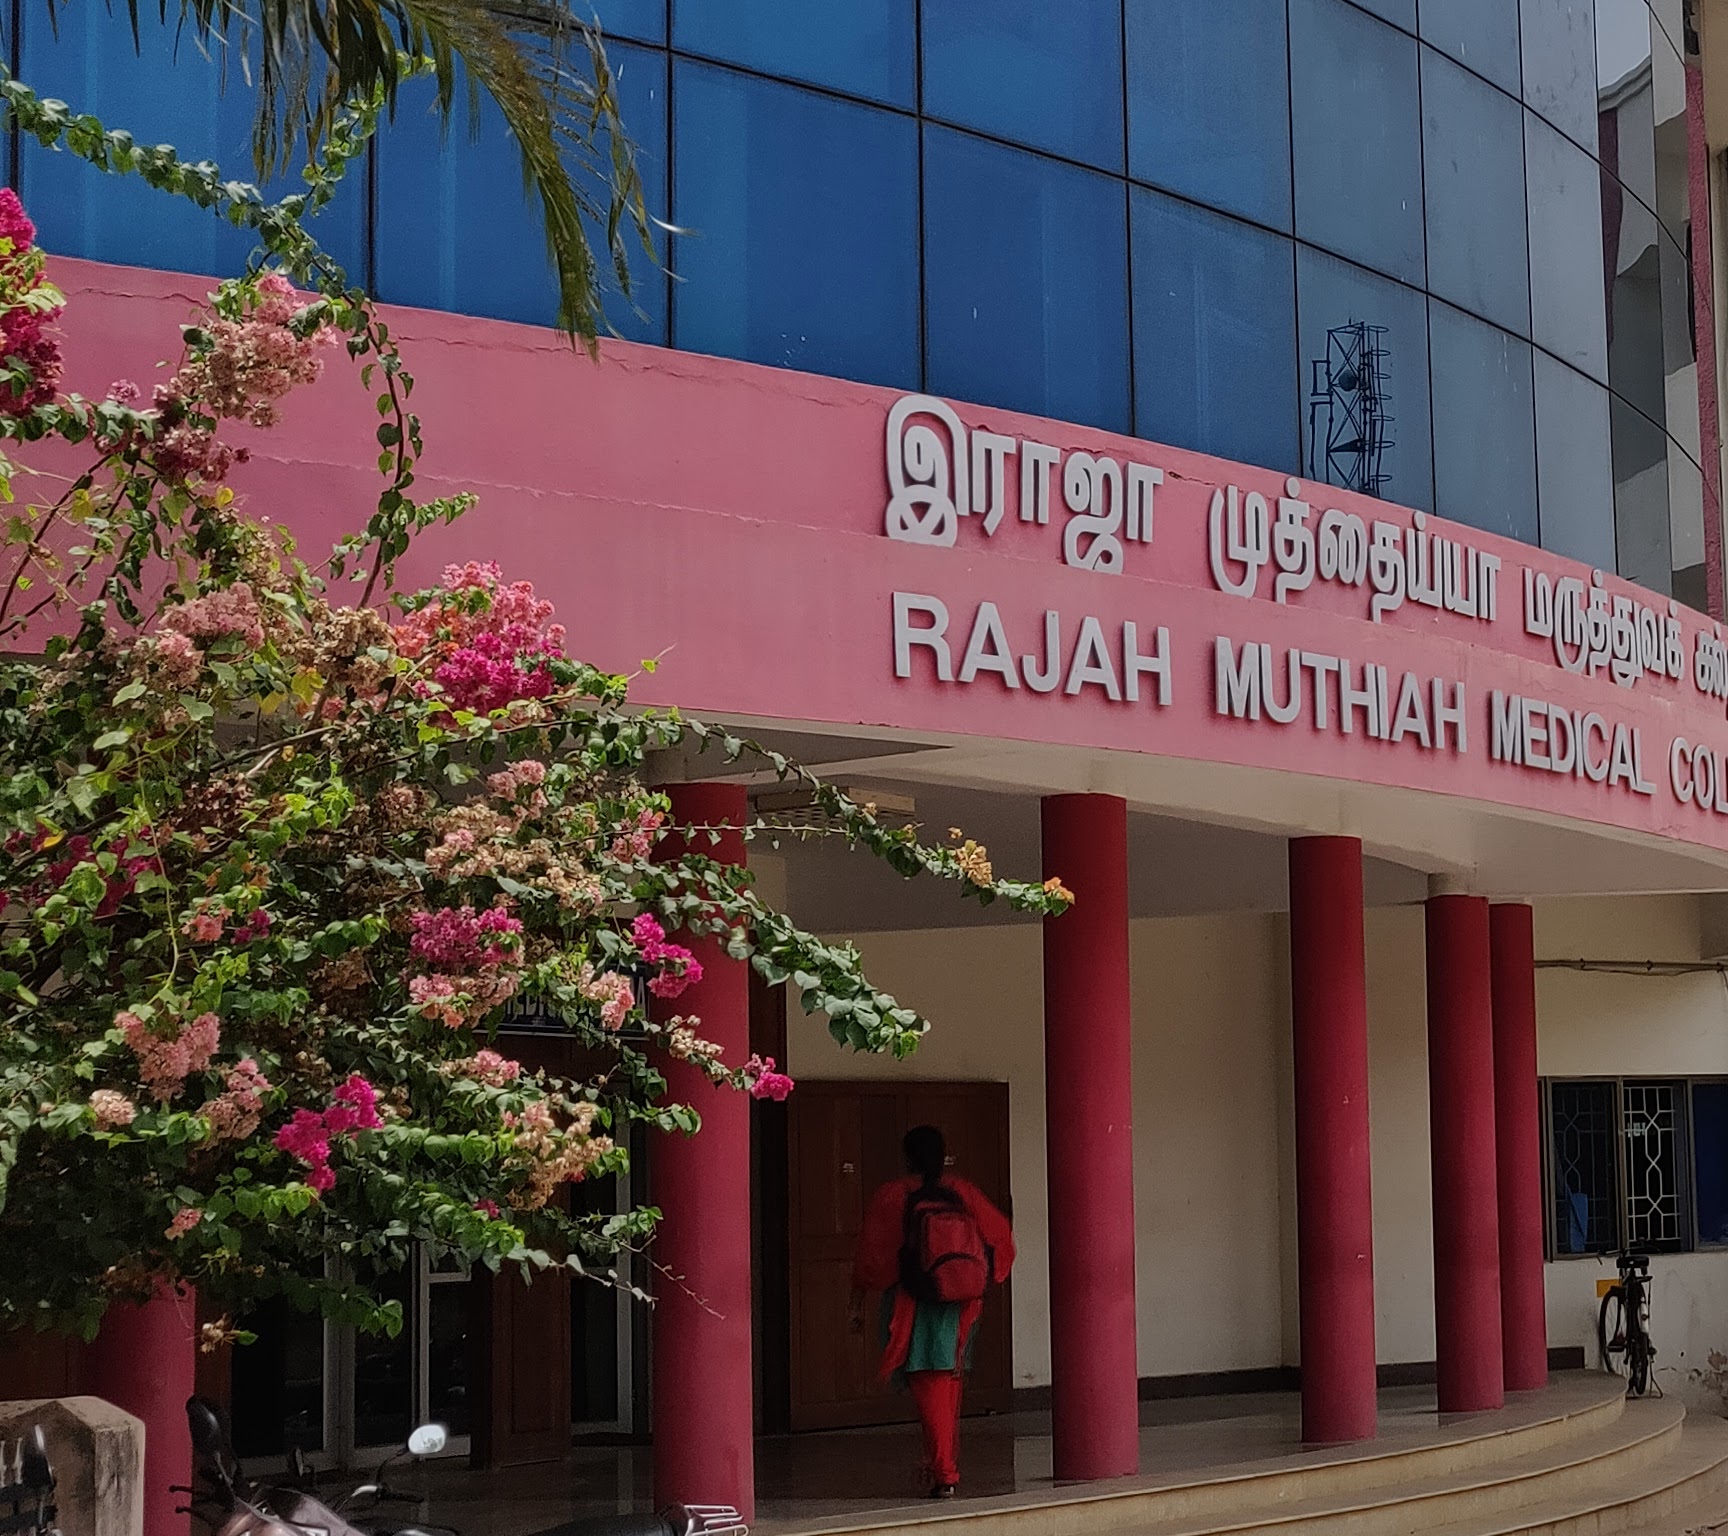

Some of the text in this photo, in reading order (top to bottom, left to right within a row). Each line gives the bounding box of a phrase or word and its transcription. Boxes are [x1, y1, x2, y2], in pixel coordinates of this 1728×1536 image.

[886, 394, 1163, 574] இராஜா
[892, 591, 1172, 706] RAJAH
[1215, 636, 1466, 750] MUTHIAH
[1491, 689, 1656, 794] MEDICAL
